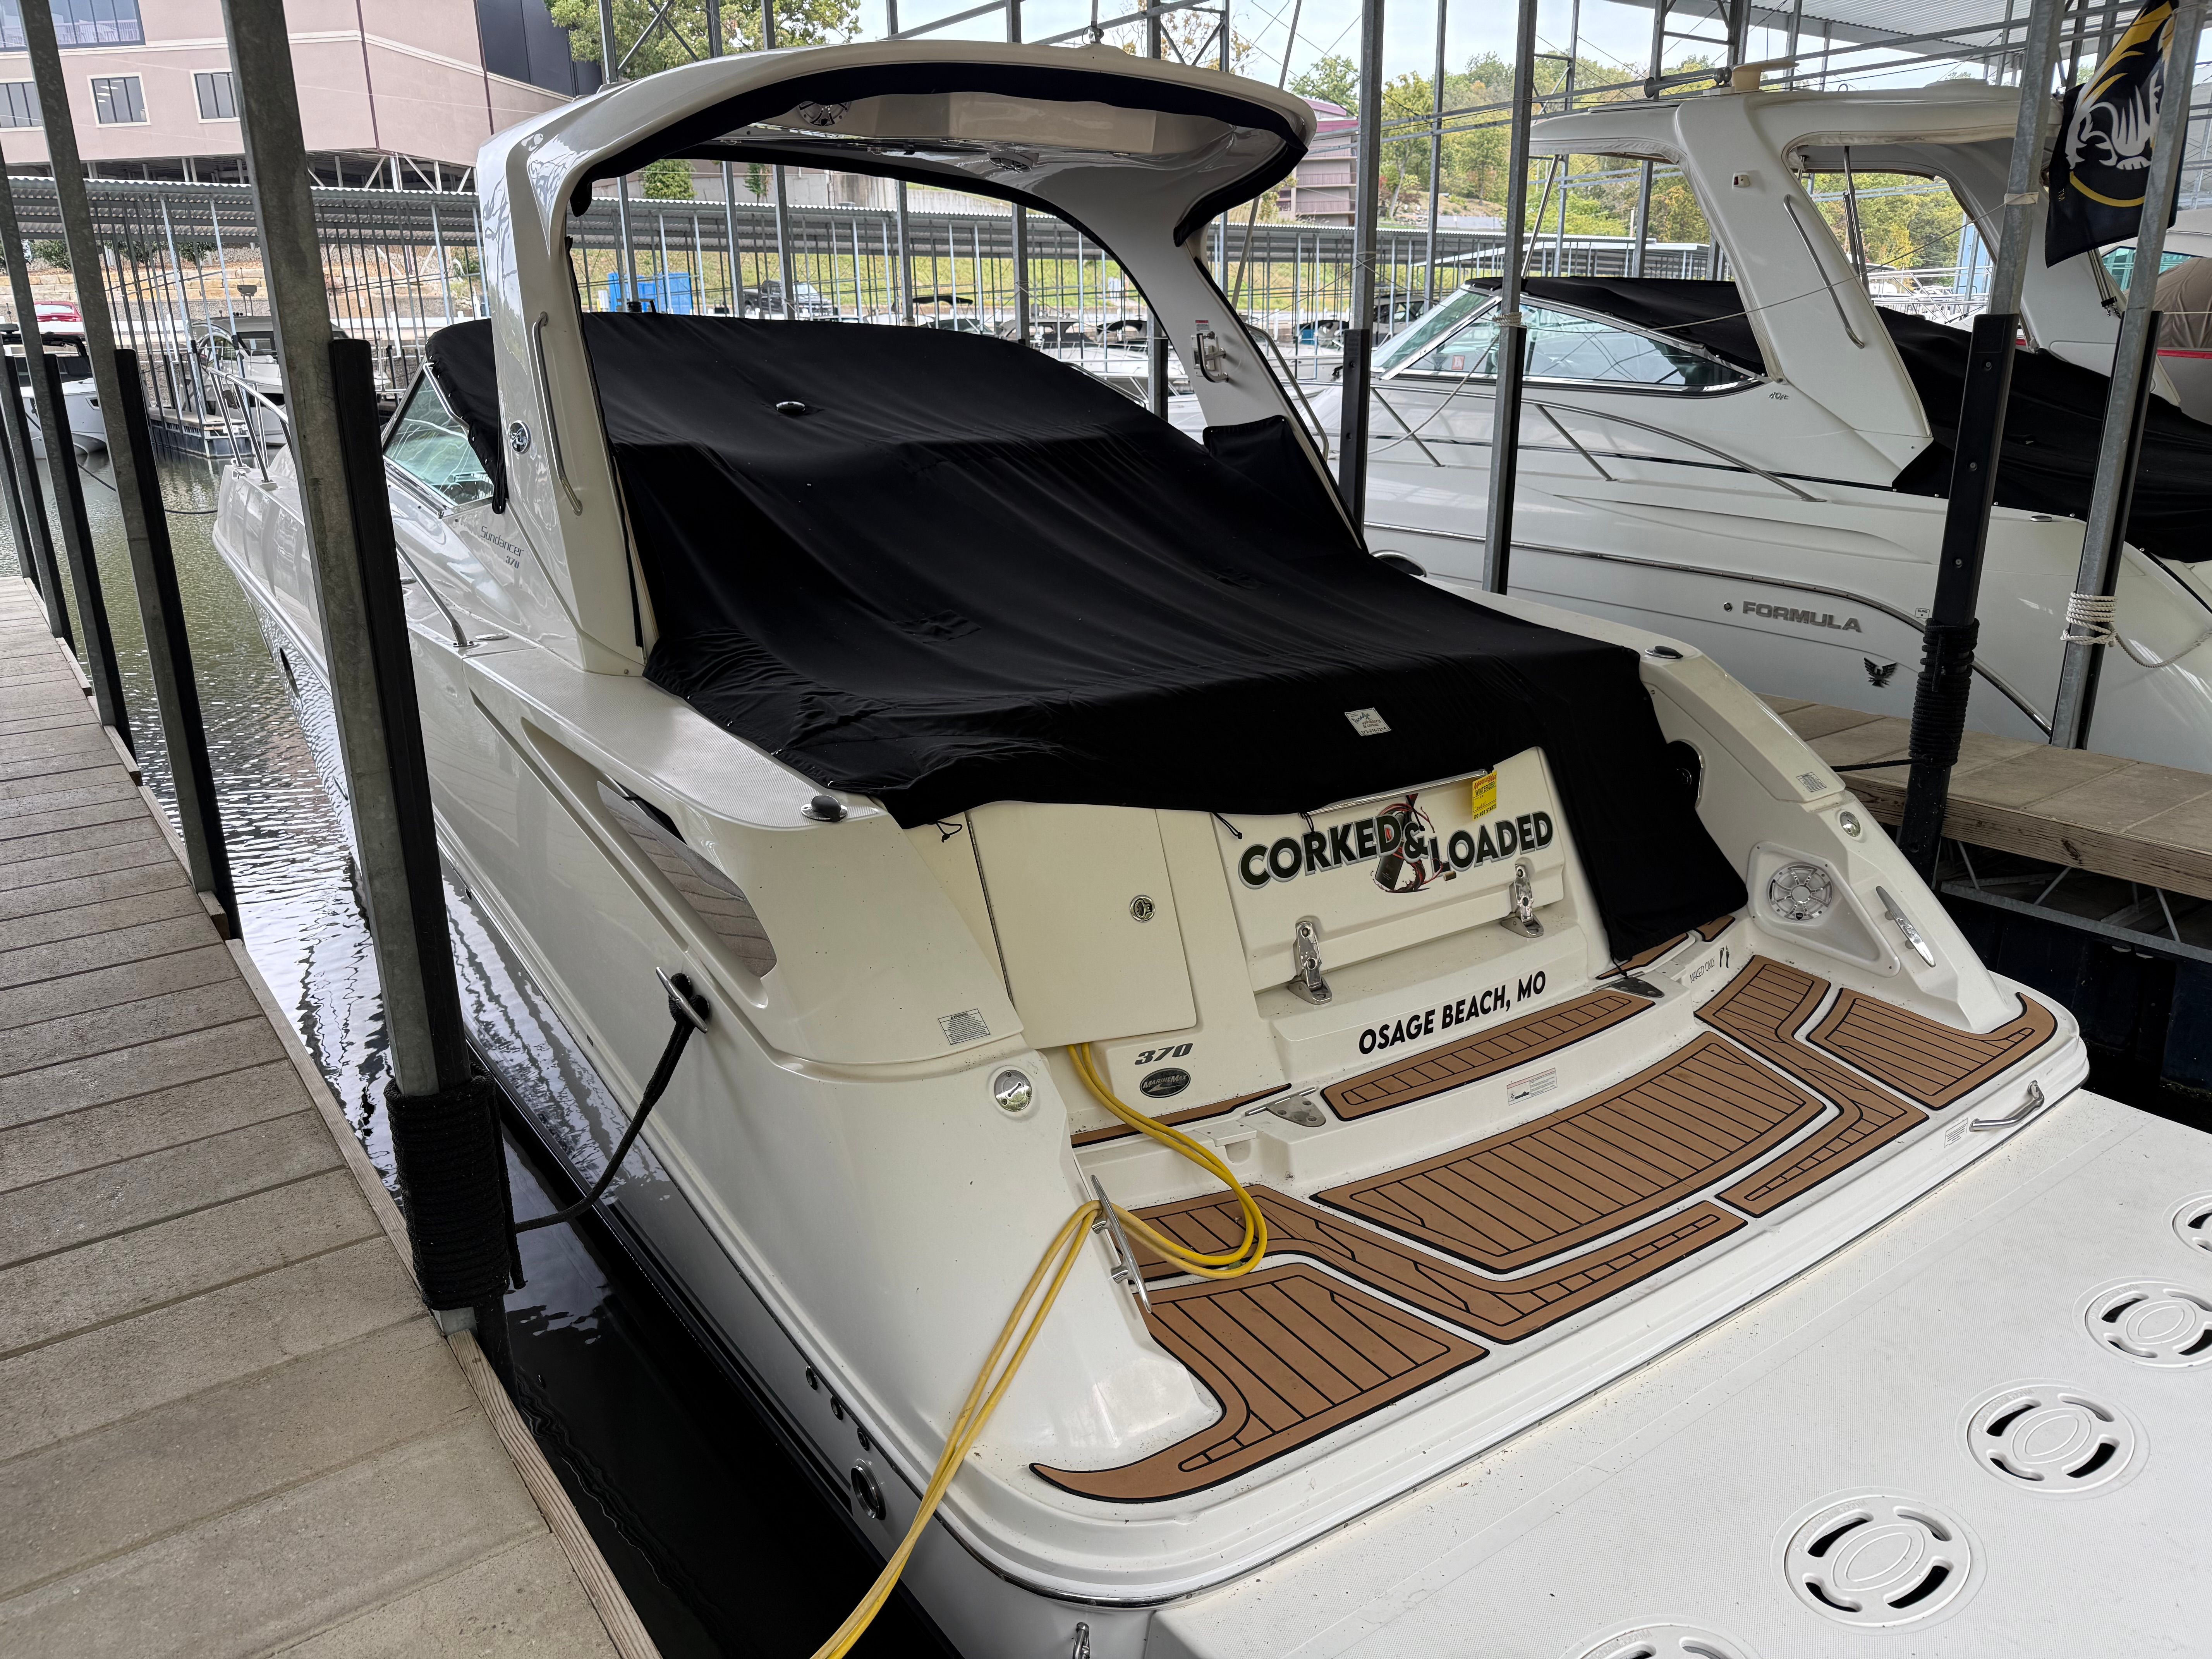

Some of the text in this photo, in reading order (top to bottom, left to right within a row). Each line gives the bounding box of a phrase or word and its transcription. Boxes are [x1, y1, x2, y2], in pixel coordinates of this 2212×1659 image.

[480, 526, 524, 556] Sundancer
[505, 556, 520, 569] 370
[1742, 601, 1862, 633] FORMULA
[1238, 811, 1553, 890] CORKED & LOADED
[1690, 956, 1715, 983] NAKED ONLY
[1359, 971, 1546, 1054] OSAGE BEACH, MO
[1135, 1043, 1193, 1065] 370
